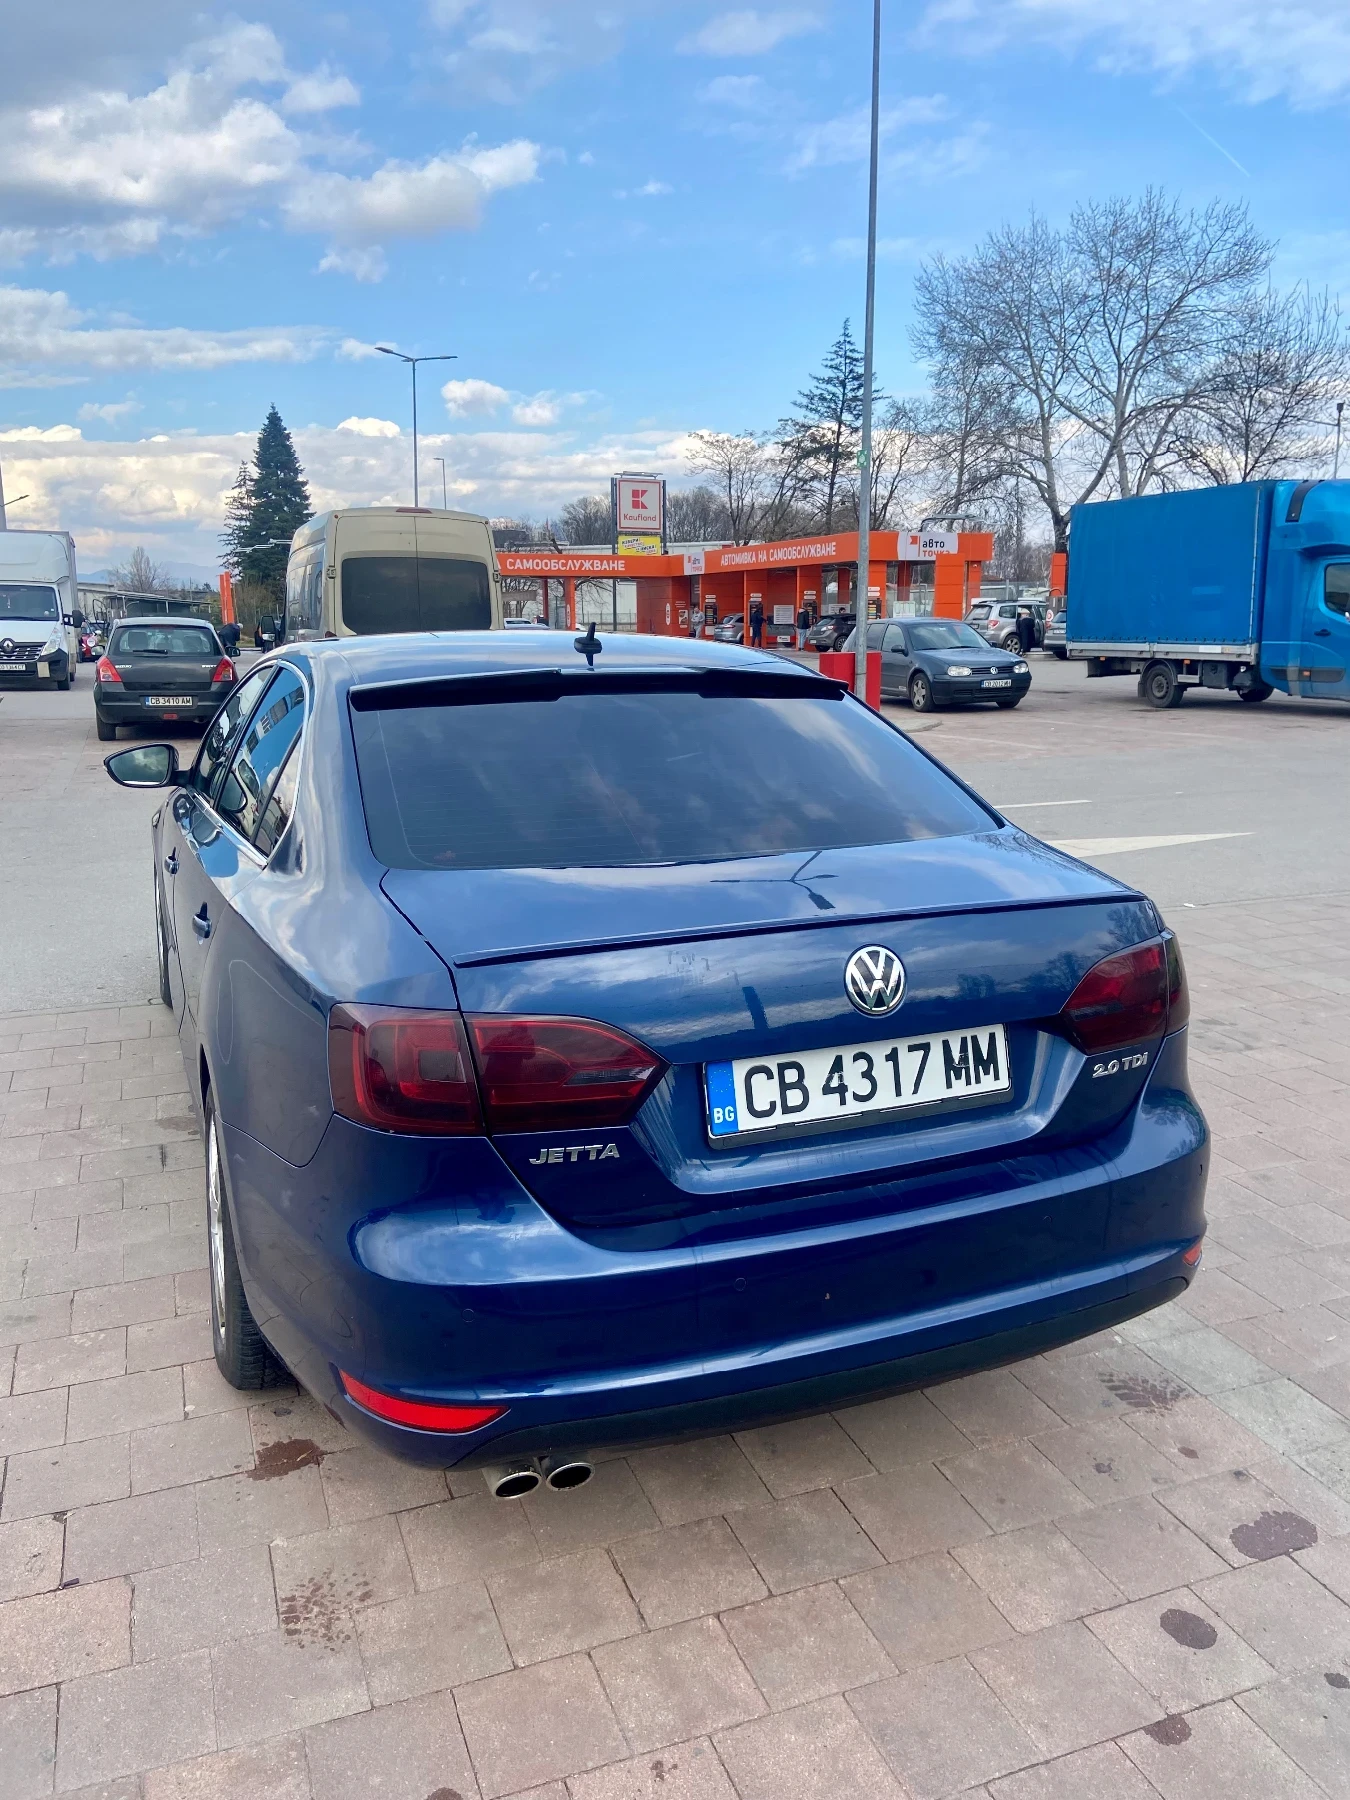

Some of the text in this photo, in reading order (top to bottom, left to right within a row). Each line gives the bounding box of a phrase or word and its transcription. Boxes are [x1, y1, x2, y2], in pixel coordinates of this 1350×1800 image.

[623, 513, 657, 522] Kaufland
[922, 538, 945, 548] авто
[720, 542, 837, 567] АВТОМИВКА НА САМООБСЛУЖВАНЕ
[506, 558, 626, 571] САМООБСЛУЖВАНЕ
[150, 697, 160, 705] CB
[161, 697, 180, 705] 3410
[181, 697, 191, 705] AM
[744, 1031, 1000, 1119] CB 4317 MM
[713, 1106, 735, 1124] BG
[528, 1143, 620, 1165] JETTA
